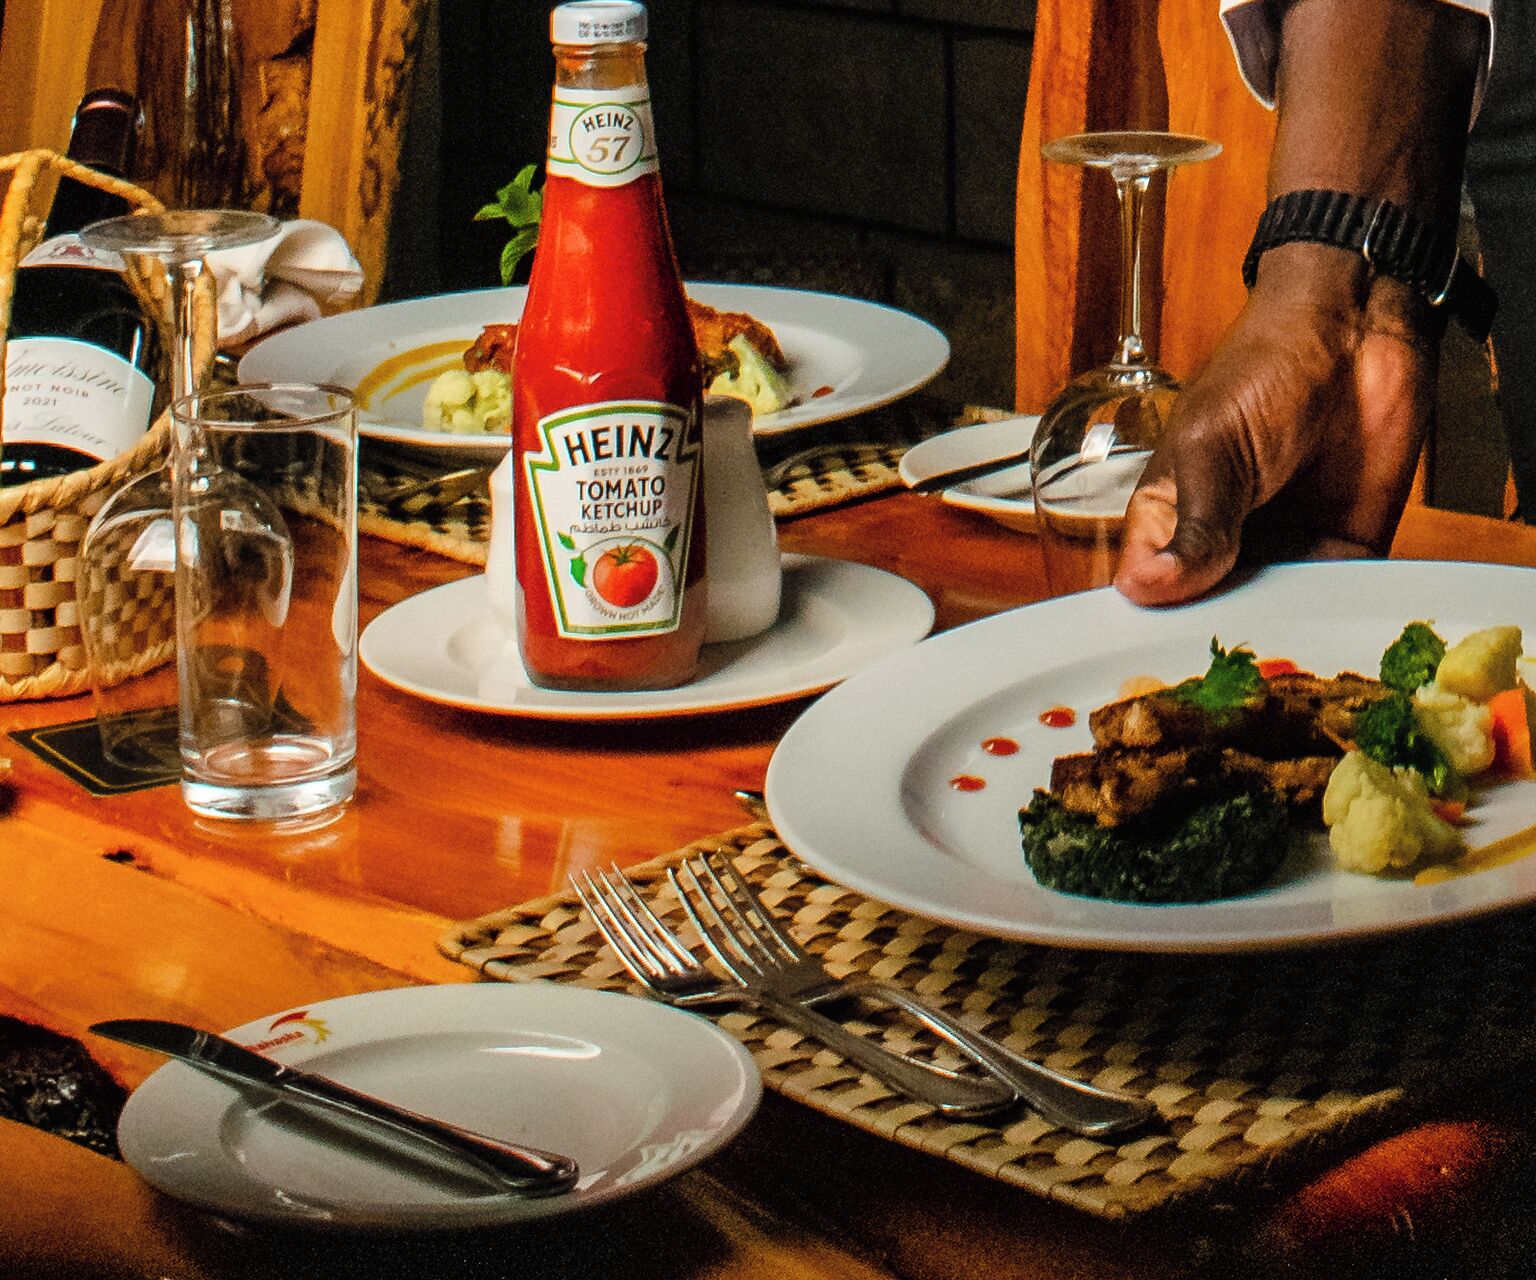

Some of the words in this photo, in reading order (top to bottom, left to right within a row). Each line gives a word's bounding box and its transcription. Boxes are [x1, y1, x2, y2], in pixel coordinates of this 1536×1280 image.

[582, 111, 634, 133] HEINZ
[586, 135, 631, 163] 57
[10, 383, 41, 392] NOT
[51, 384, 89, 398] NOIR
[22, 396, 58, 407] 2021
[563, 424, 674, 466] HEINZ
[623, 465, 648, 476] 1869
[576, 475, 666, 501] TOMATO
[582, 499, 663, 520] KETCHUP
